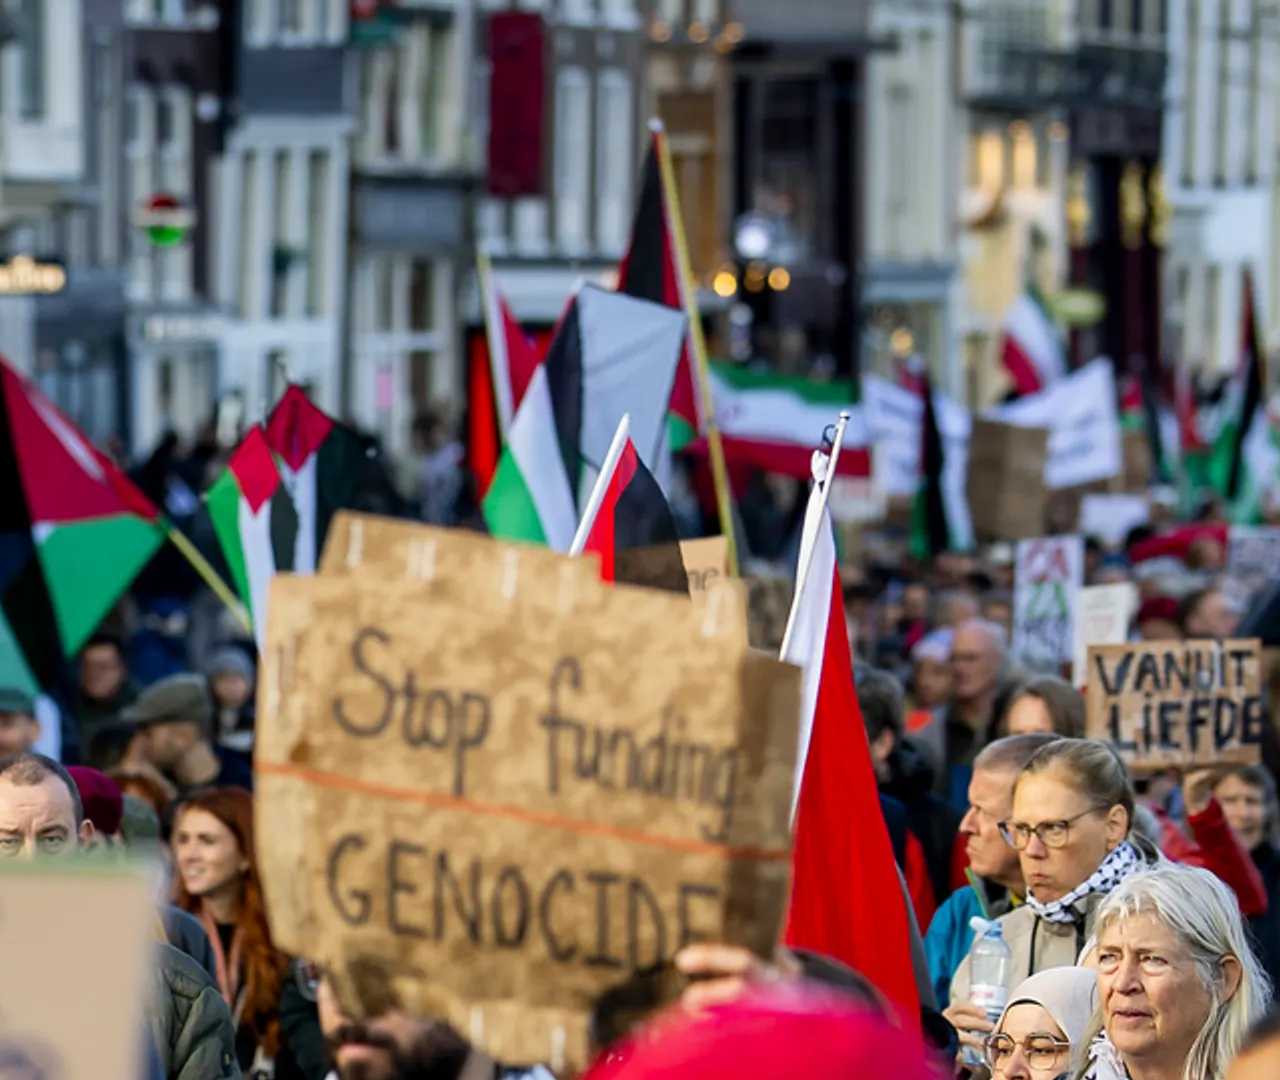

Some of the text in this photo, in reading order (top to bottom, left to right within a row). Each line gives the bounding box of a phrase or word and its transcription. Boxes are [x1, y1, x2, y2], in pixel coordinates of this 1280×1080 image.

[331, 626, 742, 844] Stop funding
[1095, 649, 1254, 696] VANUIT
[326, 833, 723, 970] GENOCIDE
